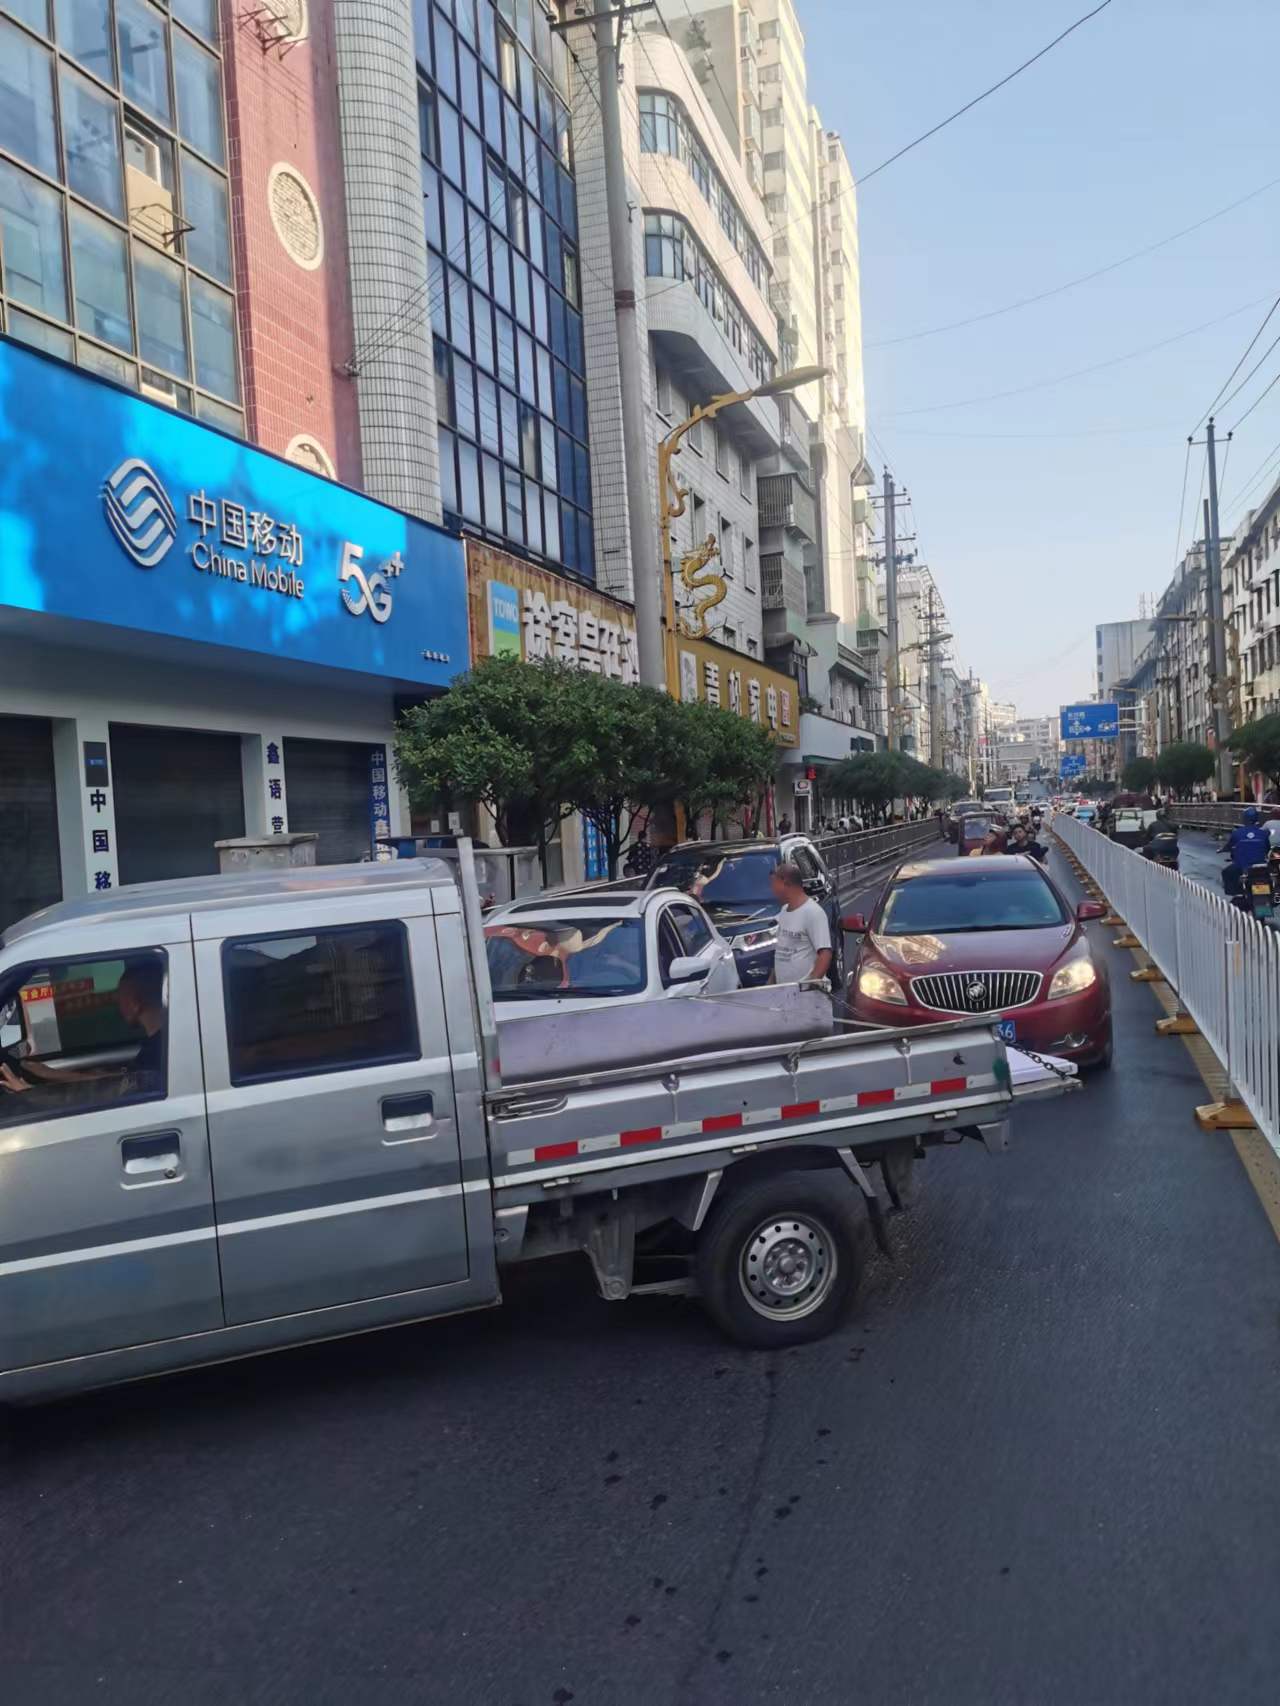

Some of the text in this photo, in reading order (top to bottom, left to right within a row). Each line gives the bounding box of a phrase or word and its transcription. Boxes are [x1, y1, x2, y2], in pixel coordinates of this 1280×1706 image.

[187, 488, 304, 566] 中国移动
[192, 542, 305, 598] China Mobile
